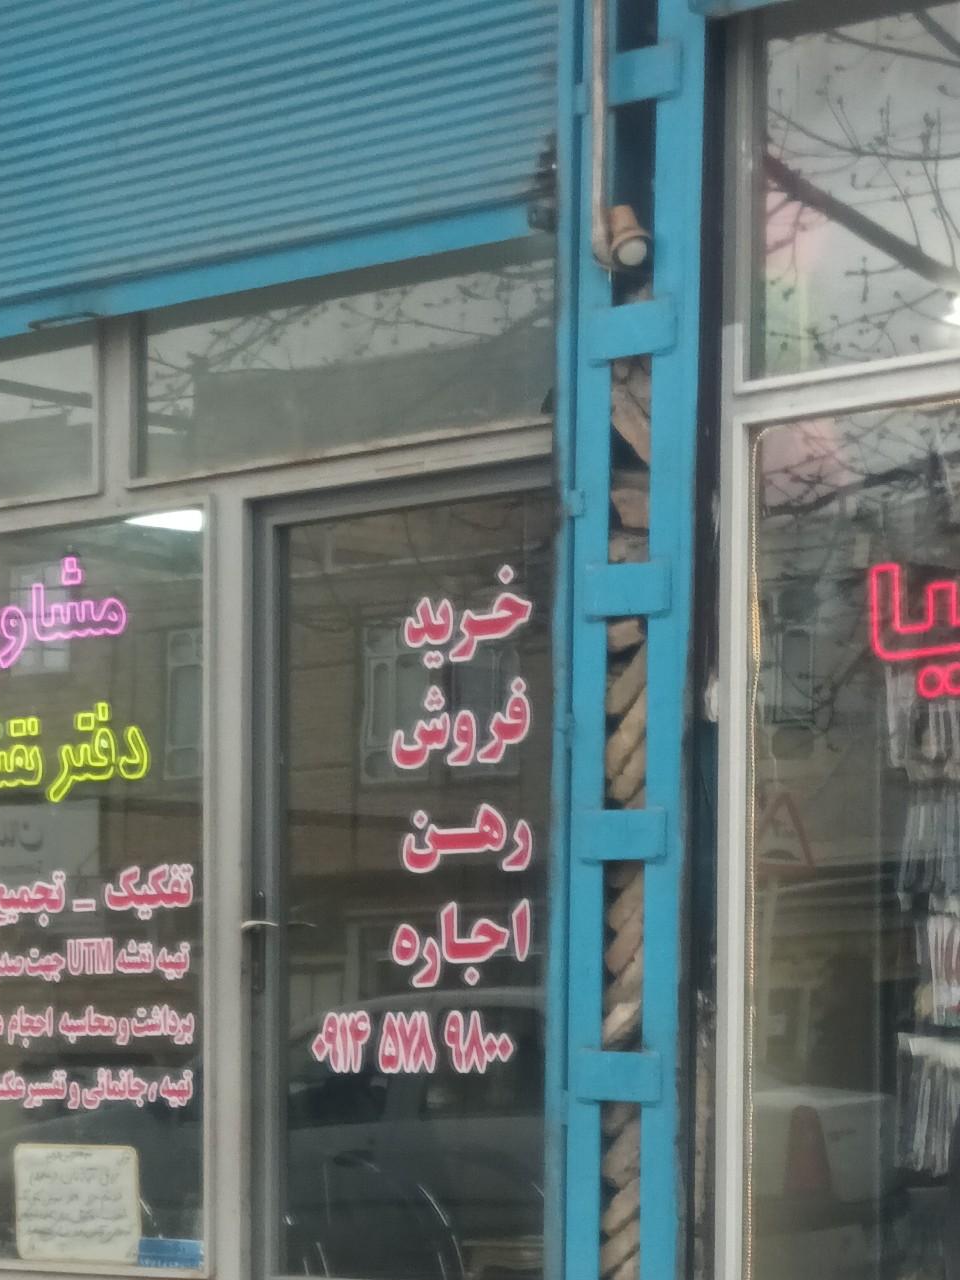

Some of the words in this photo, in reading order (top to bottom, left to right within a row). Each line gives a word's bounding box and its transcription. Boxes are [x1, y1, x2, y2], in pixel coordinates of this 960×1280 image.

[403, 563, 532, 668] خرید
[391, 677, 530, 769] فروش
[46, 701, 150, 804] دفتر
[402, 803, 532, 873] رهن
[105, 863, 194, 920] تفکیک
[67, 938, 113, 975] UTM
[115, 939, 155, 974] نقشه
[156, 942, 191, 979] تهیه
[391, 899, 531, 988] اجاره
[26, 948, 66, 982] جهت
[7, 1005, 54, 1048] احجام
[58, 1005, 116, 1043] محاسبه
[115, 1017, 131, 1045] و
[131, 1004, 195, 1044] برداشت
[312, 1010, 371, 1074] ۰۹۱۴
[378, 1011, 436, 1074] ۵۷۸
[444, 1010, 514, 1074] ۹۸۰۰
[24, 1068, 67, 1109] تفسیر
[67, 1081, 80, 1110] و
[159, 1069, 193, 1108] تهیه
